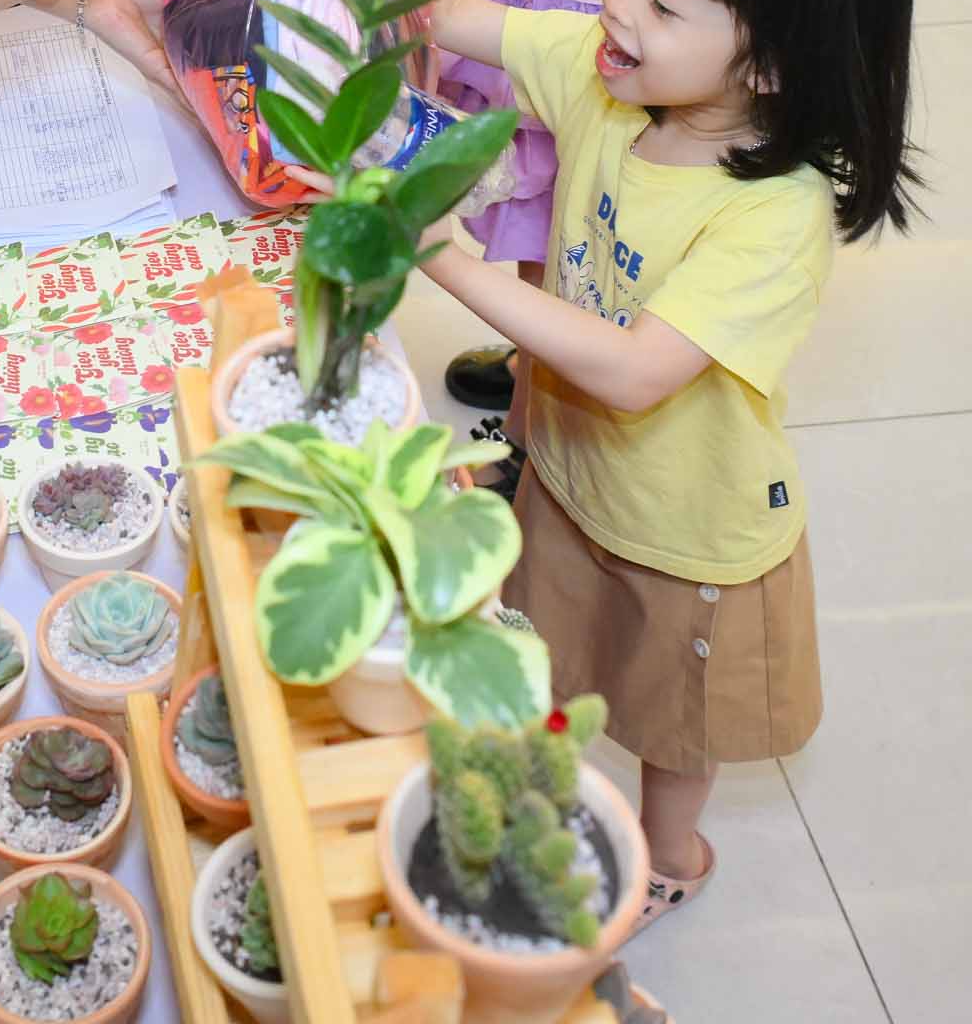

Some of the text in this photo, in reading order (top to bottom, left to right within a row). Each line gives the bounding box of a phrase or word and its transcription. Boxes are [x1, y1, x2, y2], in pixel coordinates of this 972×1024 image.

[143, 251, 173, 281] Gieo
[37, 273, 66, 303] Gieo
[171, 331, 202, 364] Gieo
[73, 351, 104, 384] Gieo
